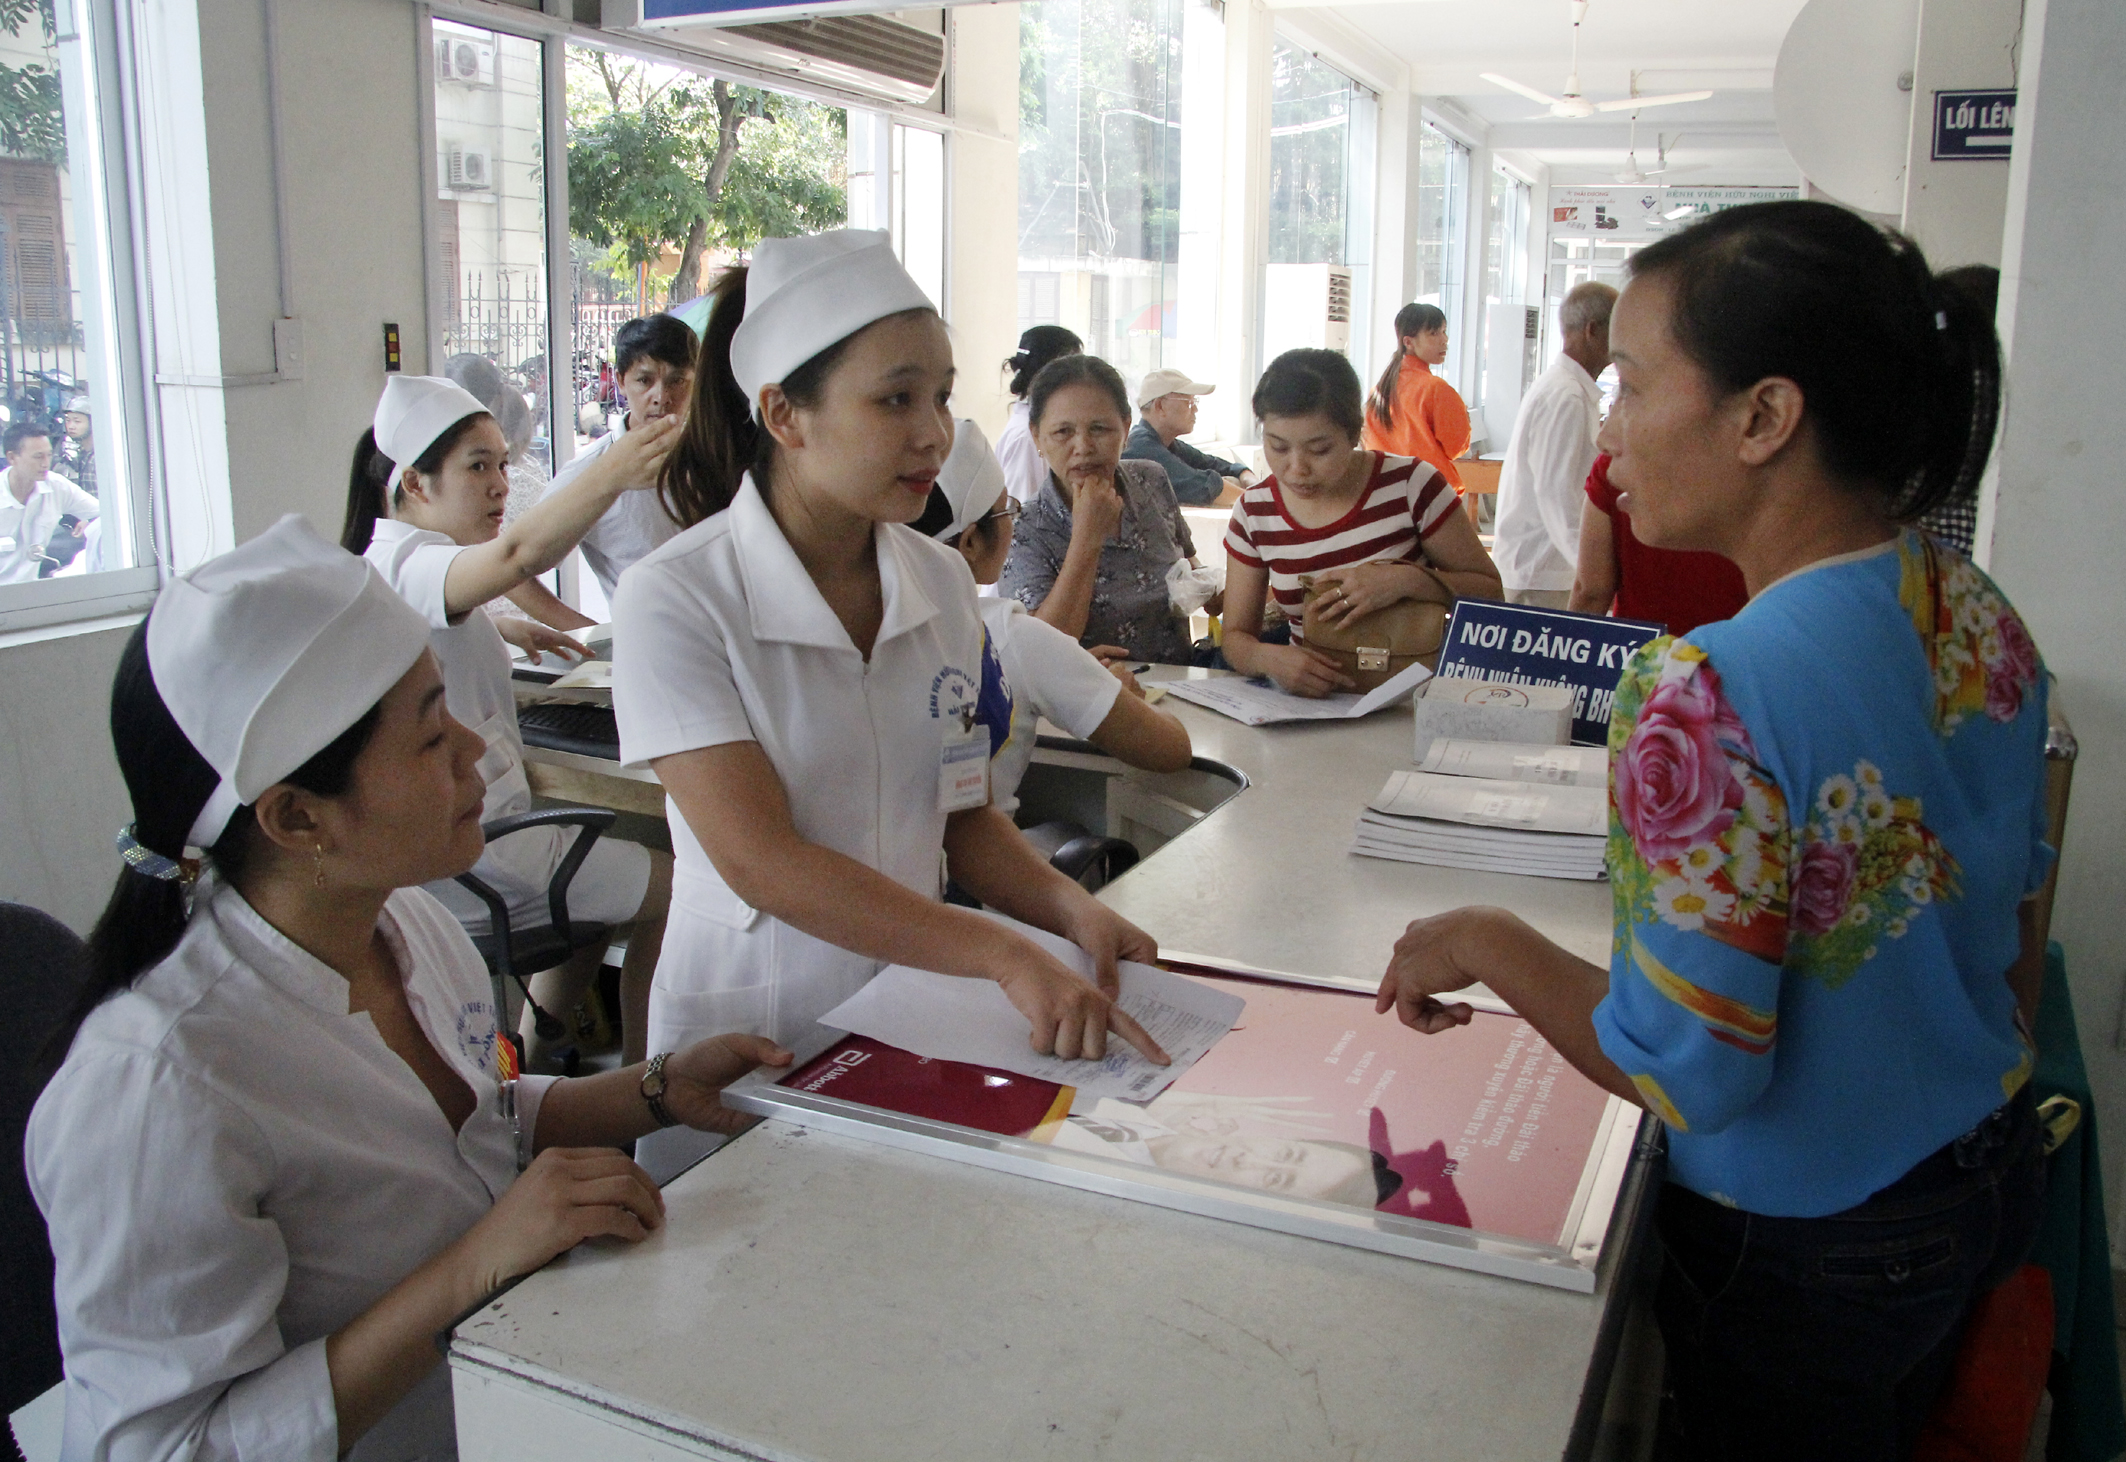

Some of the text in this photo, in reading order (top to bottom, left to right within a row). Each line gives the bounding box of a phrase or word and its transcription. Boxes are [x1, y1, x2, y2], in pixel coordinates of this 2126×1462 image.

[1945, 99, 2016, 130] LỐI LÊN
[1666, 189, 1693, 199] BỆNH
[1779, 190, 1799, 200] VIỆ
[1459, 621, 1640, 671] NƠI ĐĂNG KÝ
[1585, 687, 1616, 725] BH
[1549, 1051, 1564, 1065] ạn
[803, 1065, 849, 1091] Abbott
[1464, 1122, 1485, 1136] tra
[1459, 1137, 1477, 1145] 3
